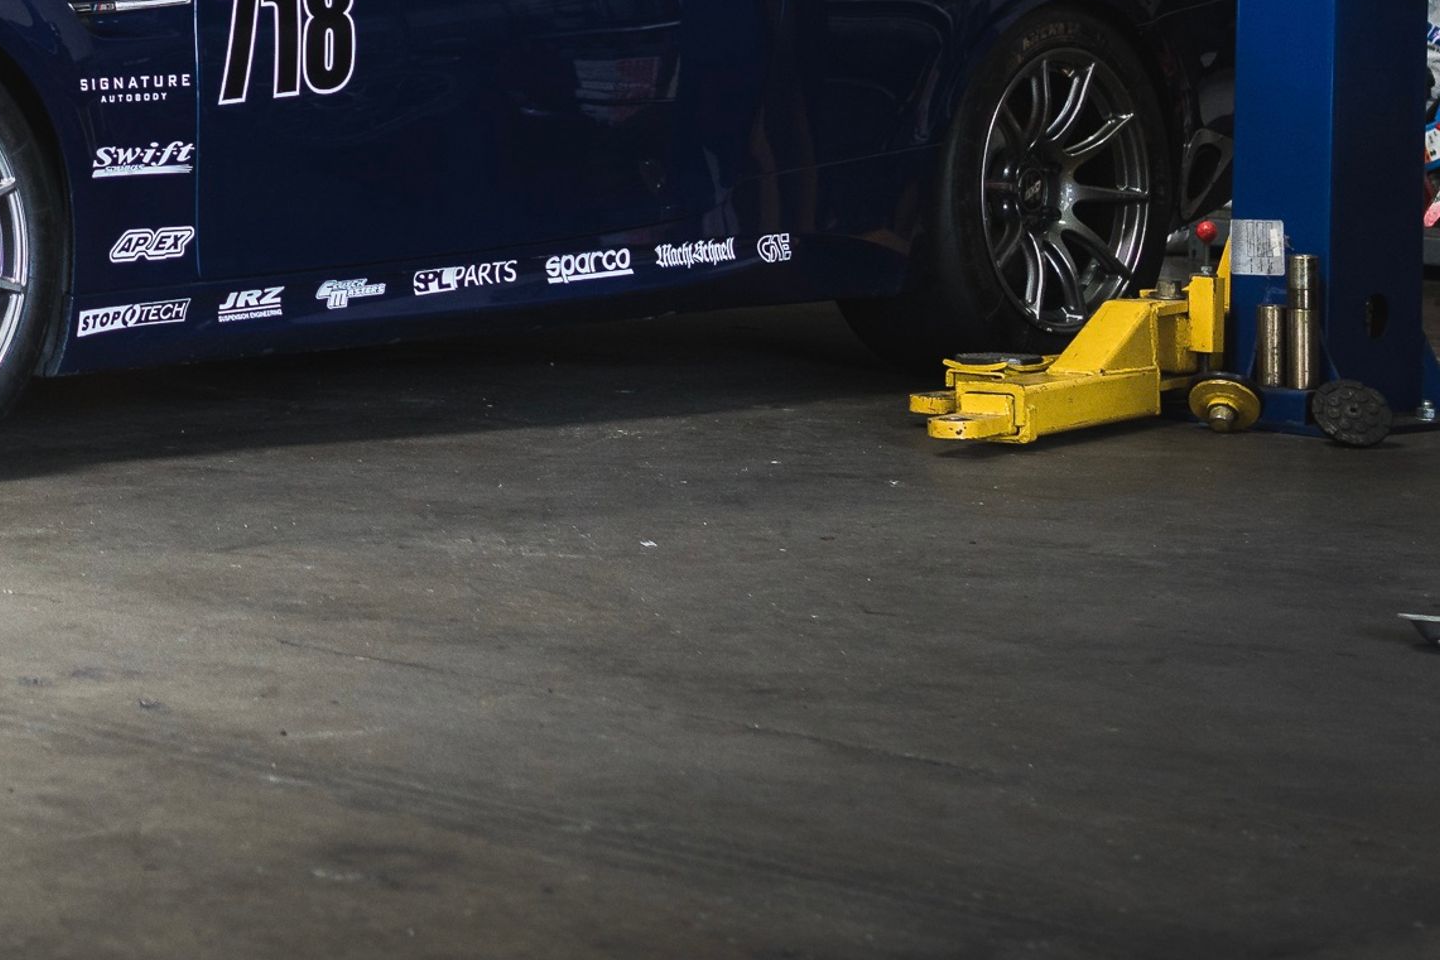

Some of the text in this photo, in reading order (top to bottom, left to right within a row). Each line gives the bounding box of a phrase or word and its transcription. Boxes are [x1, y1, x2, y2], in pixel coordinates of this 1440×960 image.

[80, 73, 191, 91] SIGNATURE
[100, 92, 168, 104] AUTOBODY
[114, 231, 190, 257] APEX
[545, 247, 633, 283] sparco
[218, 286, 285, 310] JRZ
